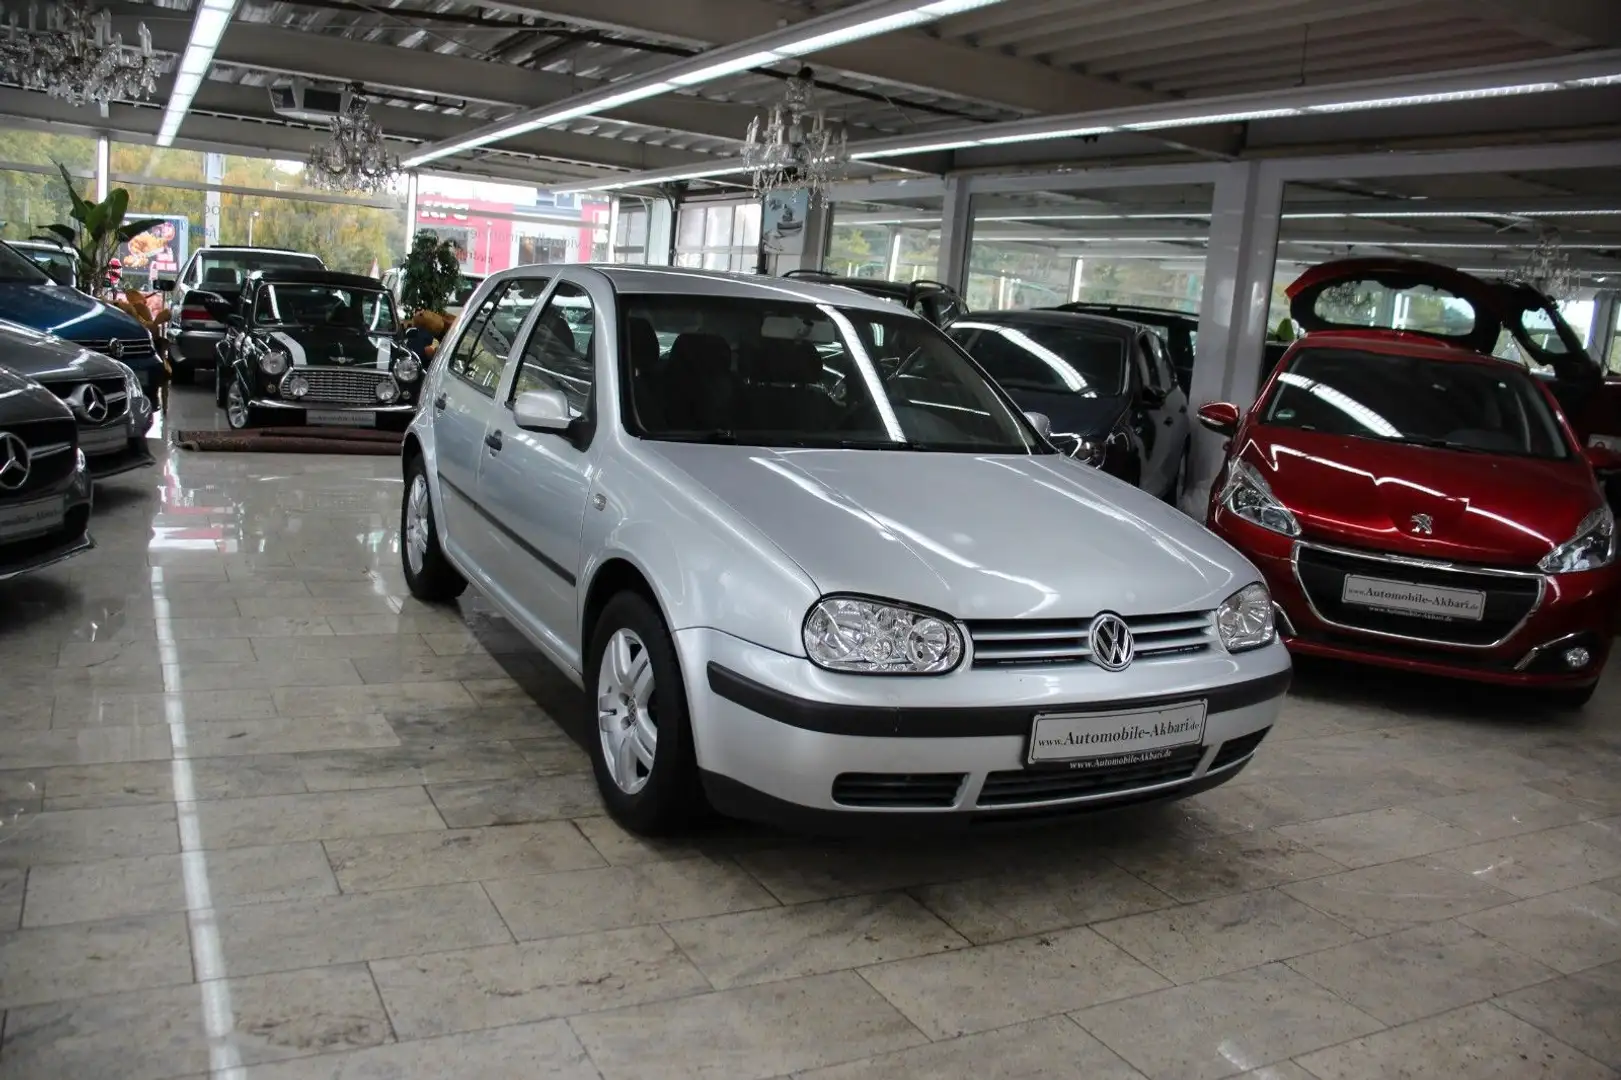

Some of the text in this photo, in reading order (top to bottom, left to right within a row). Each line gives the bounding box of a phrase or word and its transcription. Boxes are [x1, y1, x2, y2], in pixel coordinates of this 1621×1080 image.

[1348, 587, 1479, 611] www.Automobile-Akbari.de
[1038, 718, 1200, 747] www.Automobile-Akbari.de
[1069, 749, 1173, 770] www.Automobile-Akbari.de
